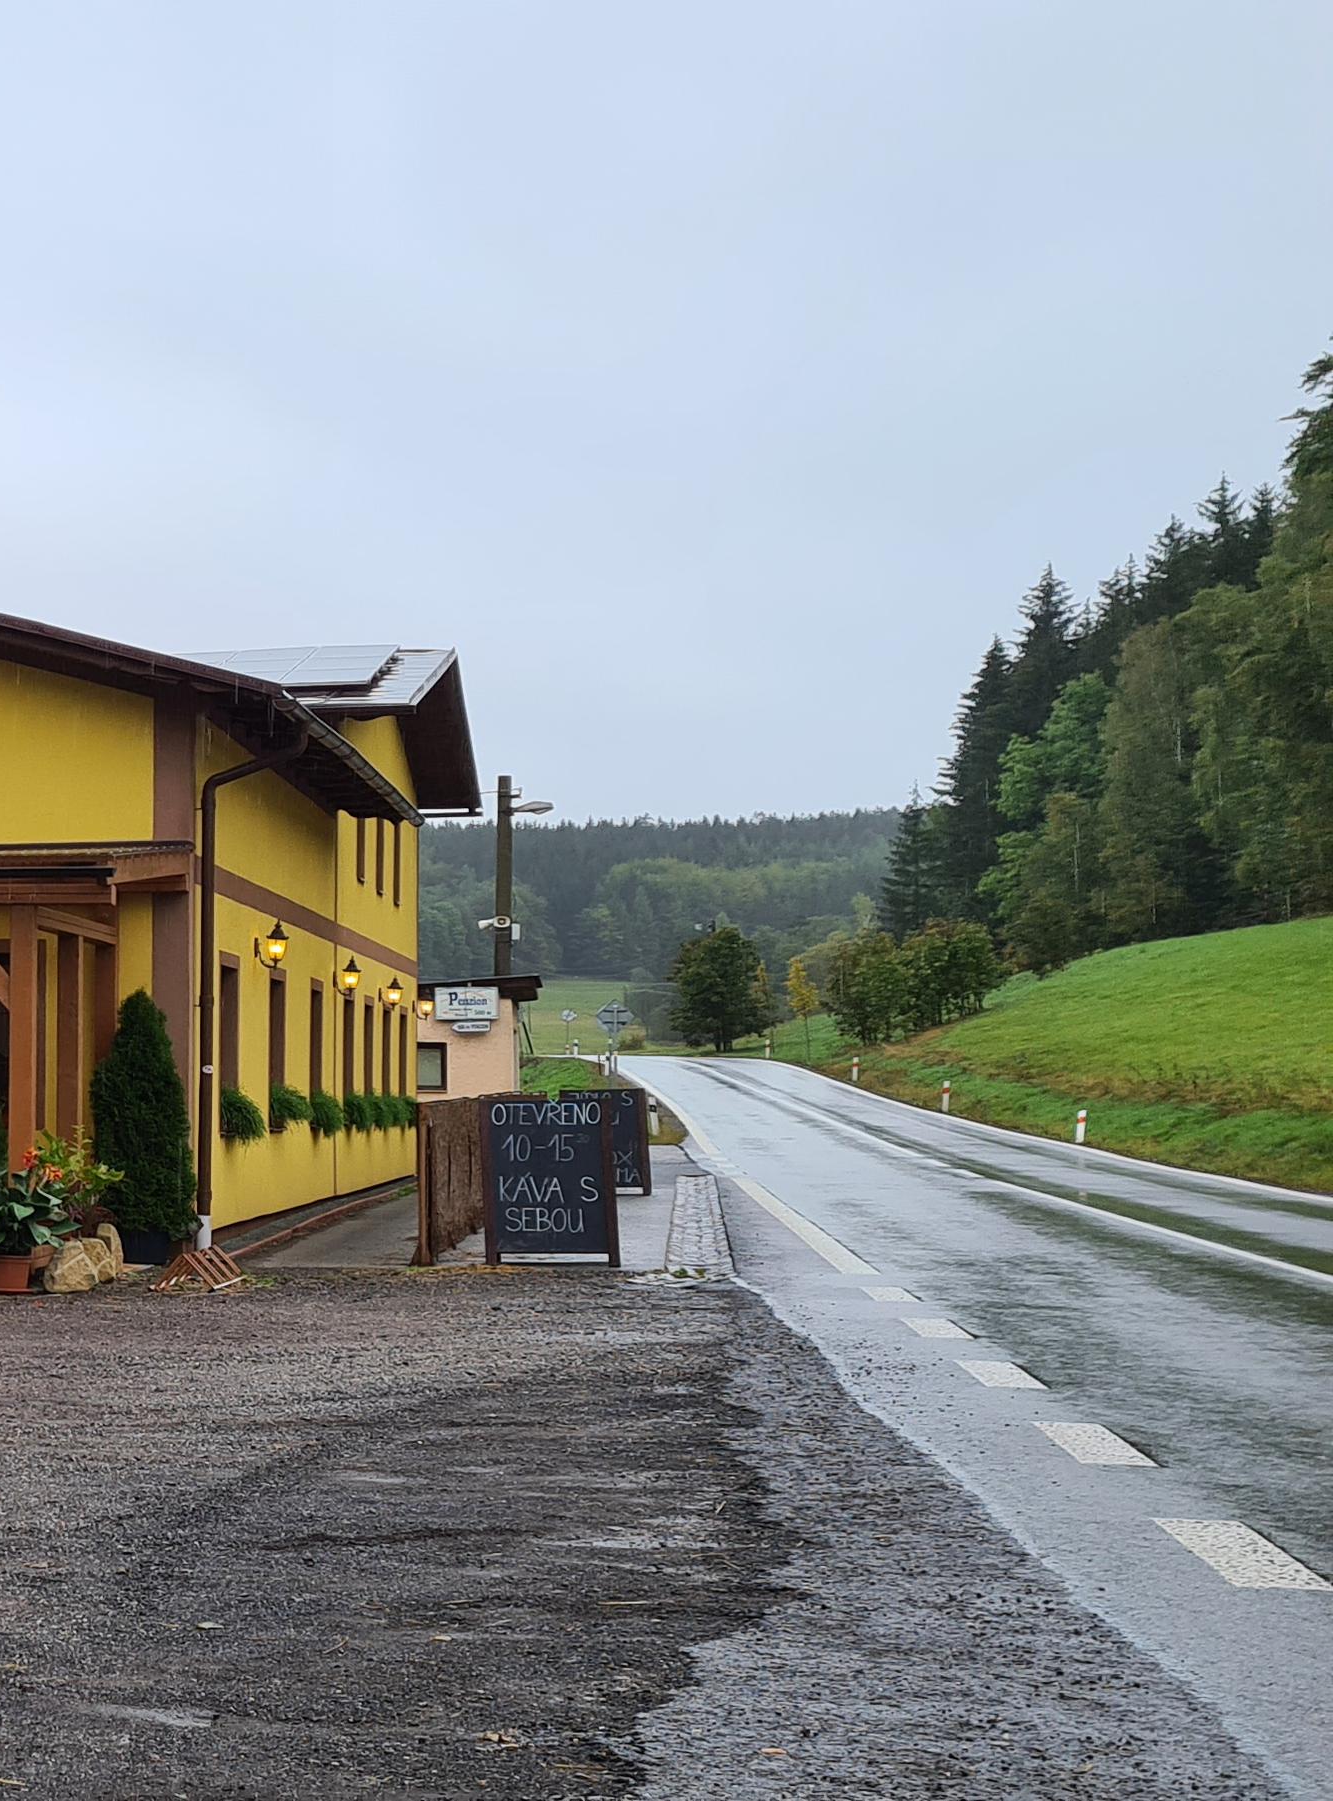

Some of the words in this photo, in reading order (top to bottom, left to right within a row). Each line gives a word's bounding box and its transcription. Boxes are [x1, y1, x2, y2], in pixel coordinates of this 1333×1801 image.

[491, 1098, 602, 1126] OTEVŘENO
[498, 1171, 565, 1204] KÁVA
[580, 1176, 600, 1202] S
[505, 1207, 585, 1234] SEBOU
